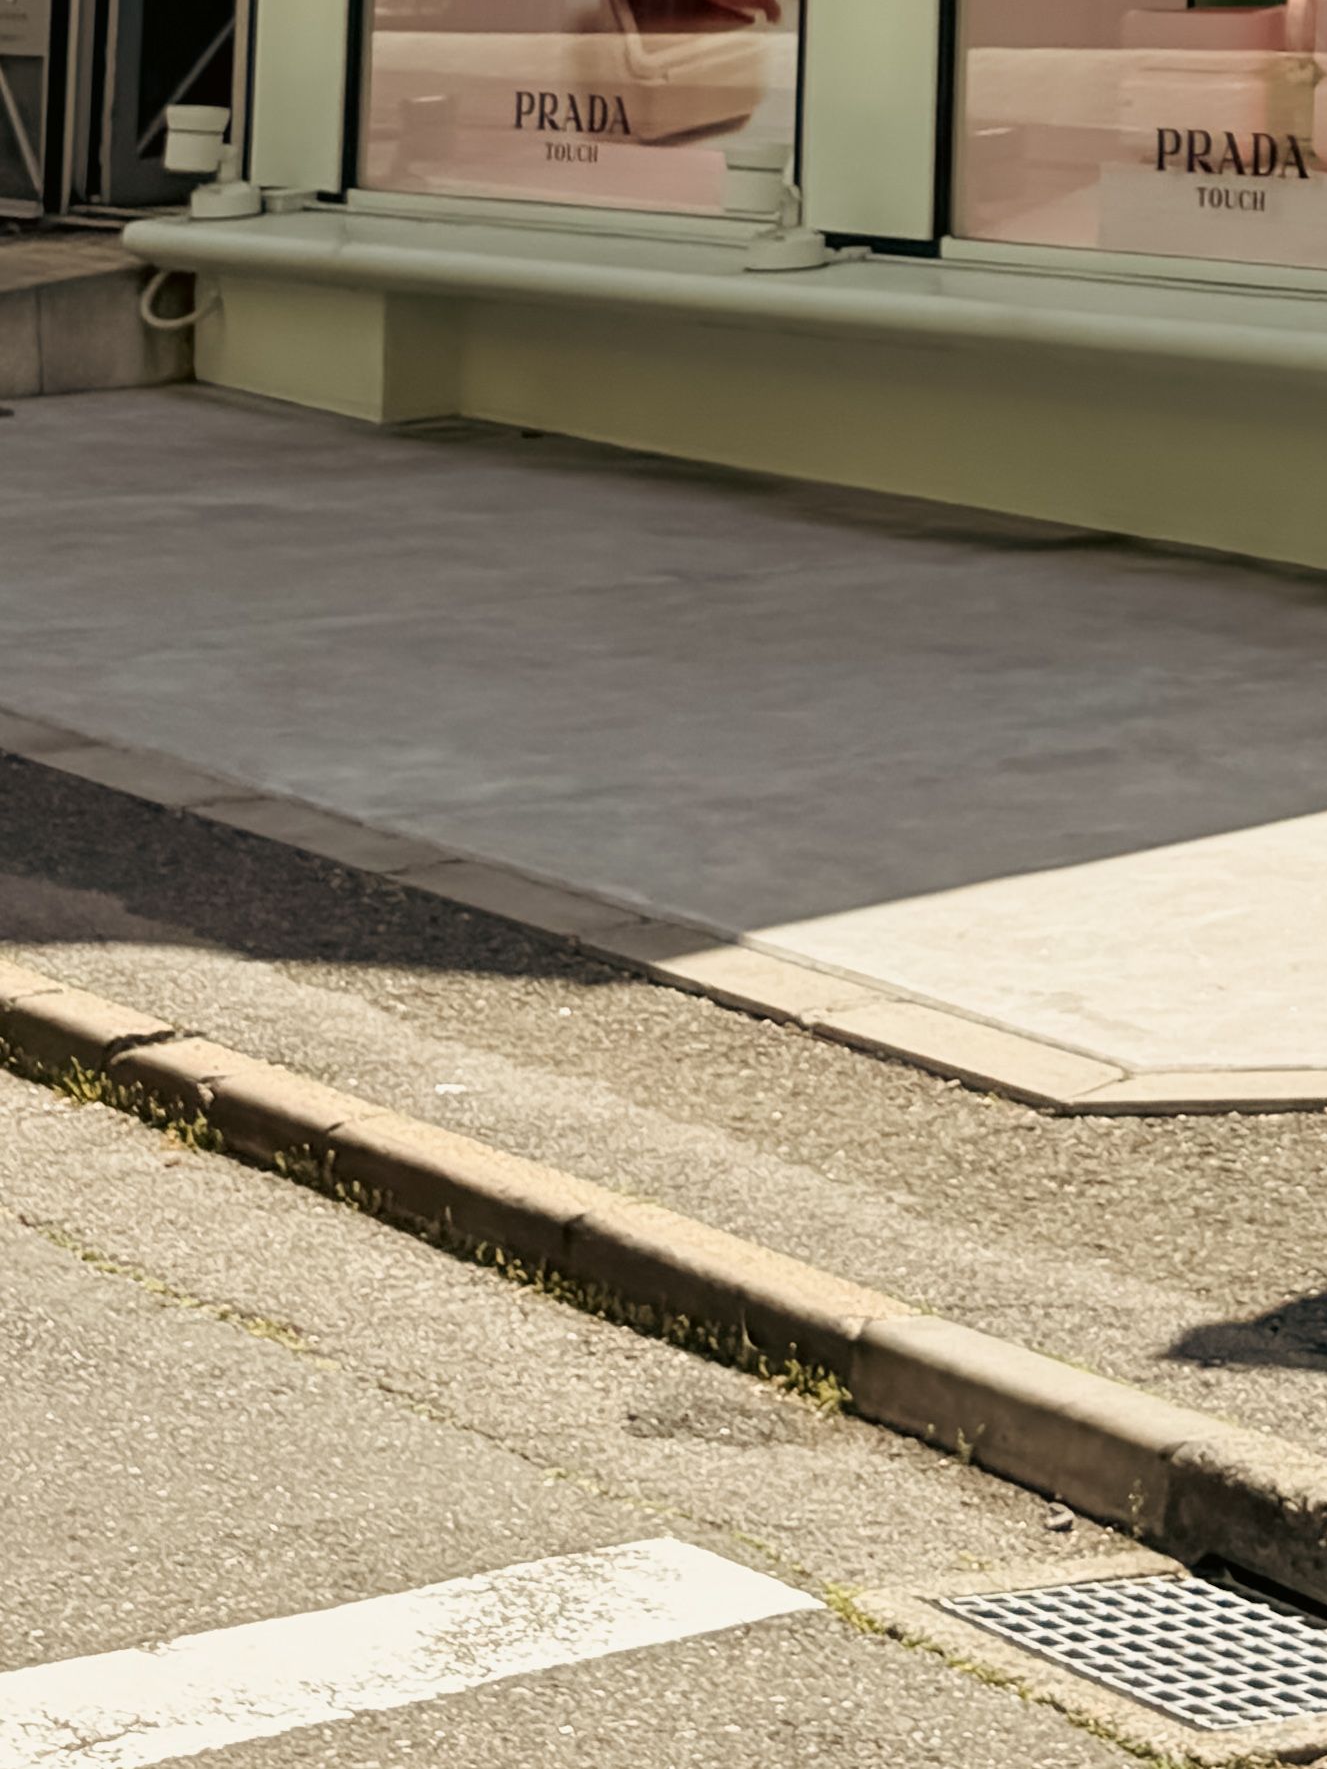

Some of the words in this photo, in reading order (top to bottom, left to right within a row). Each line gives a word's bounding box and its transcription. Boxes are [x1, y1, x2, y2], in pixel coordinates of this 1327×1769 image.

[514, 91, 632, 135] PRADA
[545, 142, 598, 163] TOUCH
[1156, 128, 1310, 179] PRADA
[1197, 186, 1266, 212] TOUCH
